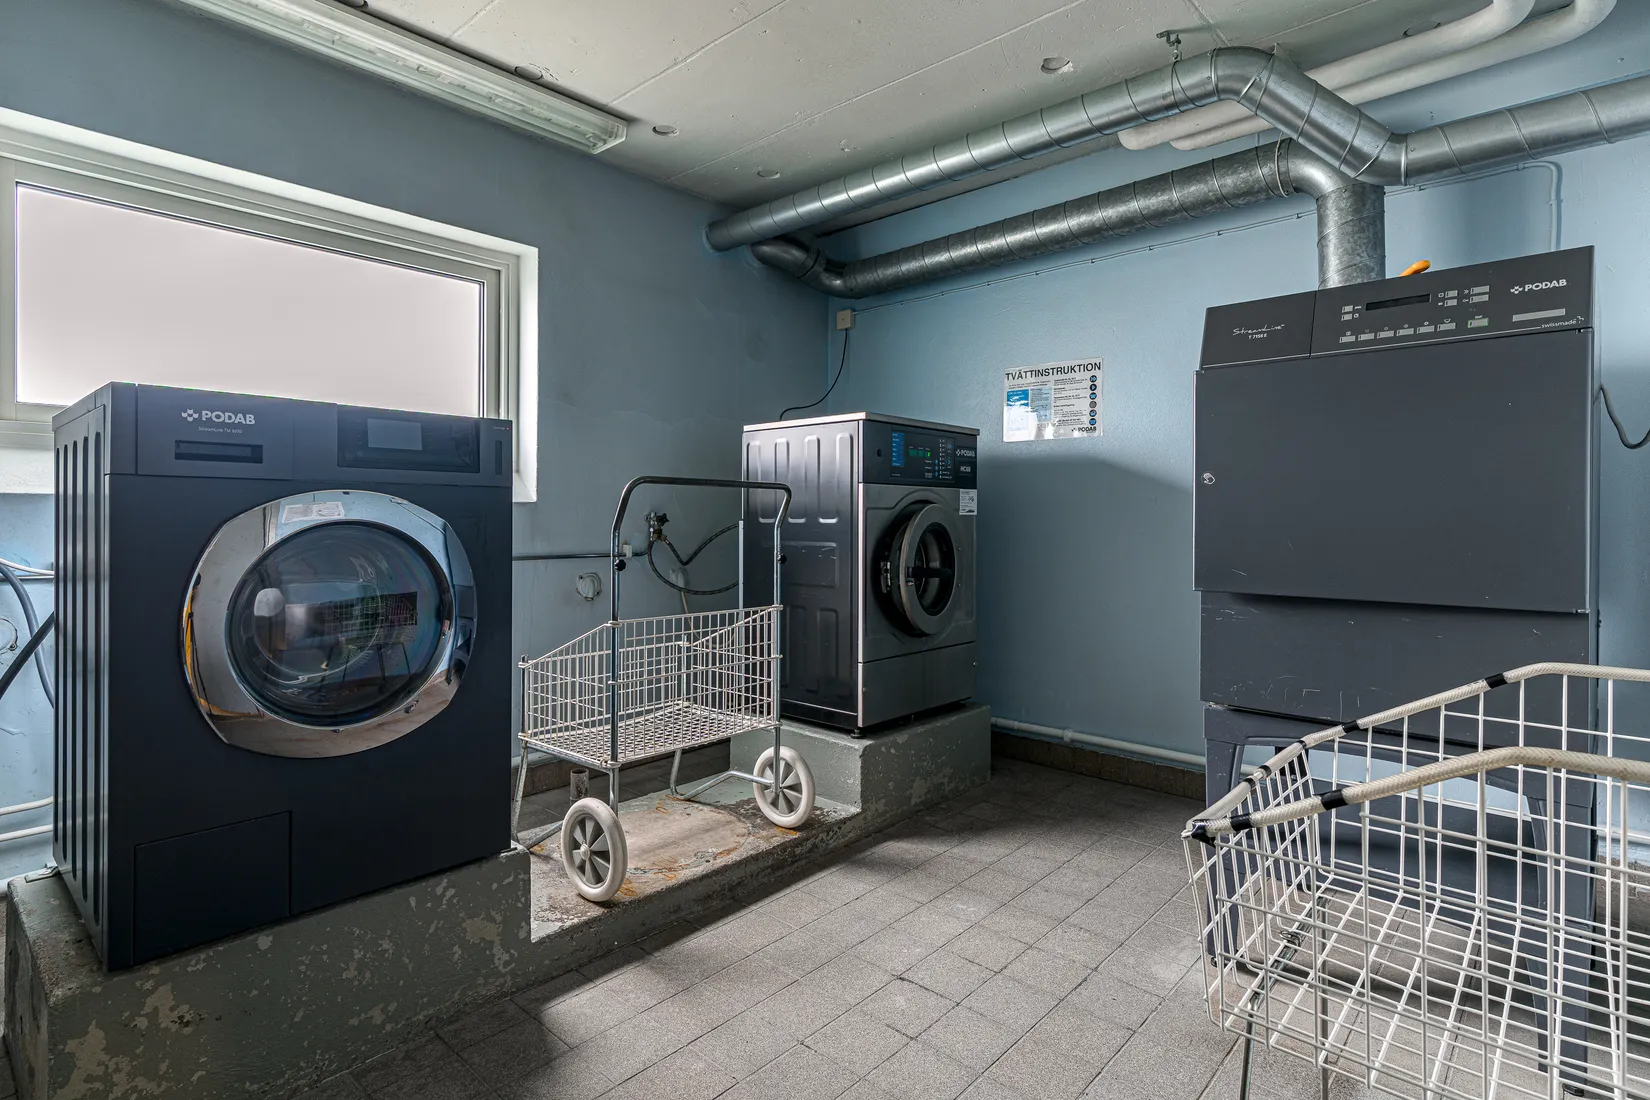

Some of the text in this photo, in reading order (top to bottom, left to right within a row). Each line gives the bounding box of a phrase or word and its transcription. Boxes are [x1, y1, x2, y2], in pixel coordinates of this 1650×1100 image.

[1525, 279, 1567, 292] PODAB
[1005, 361, 1101, 381] TVÄTTINSTRUKTION
[202, 410, 256, 425] PODAB
